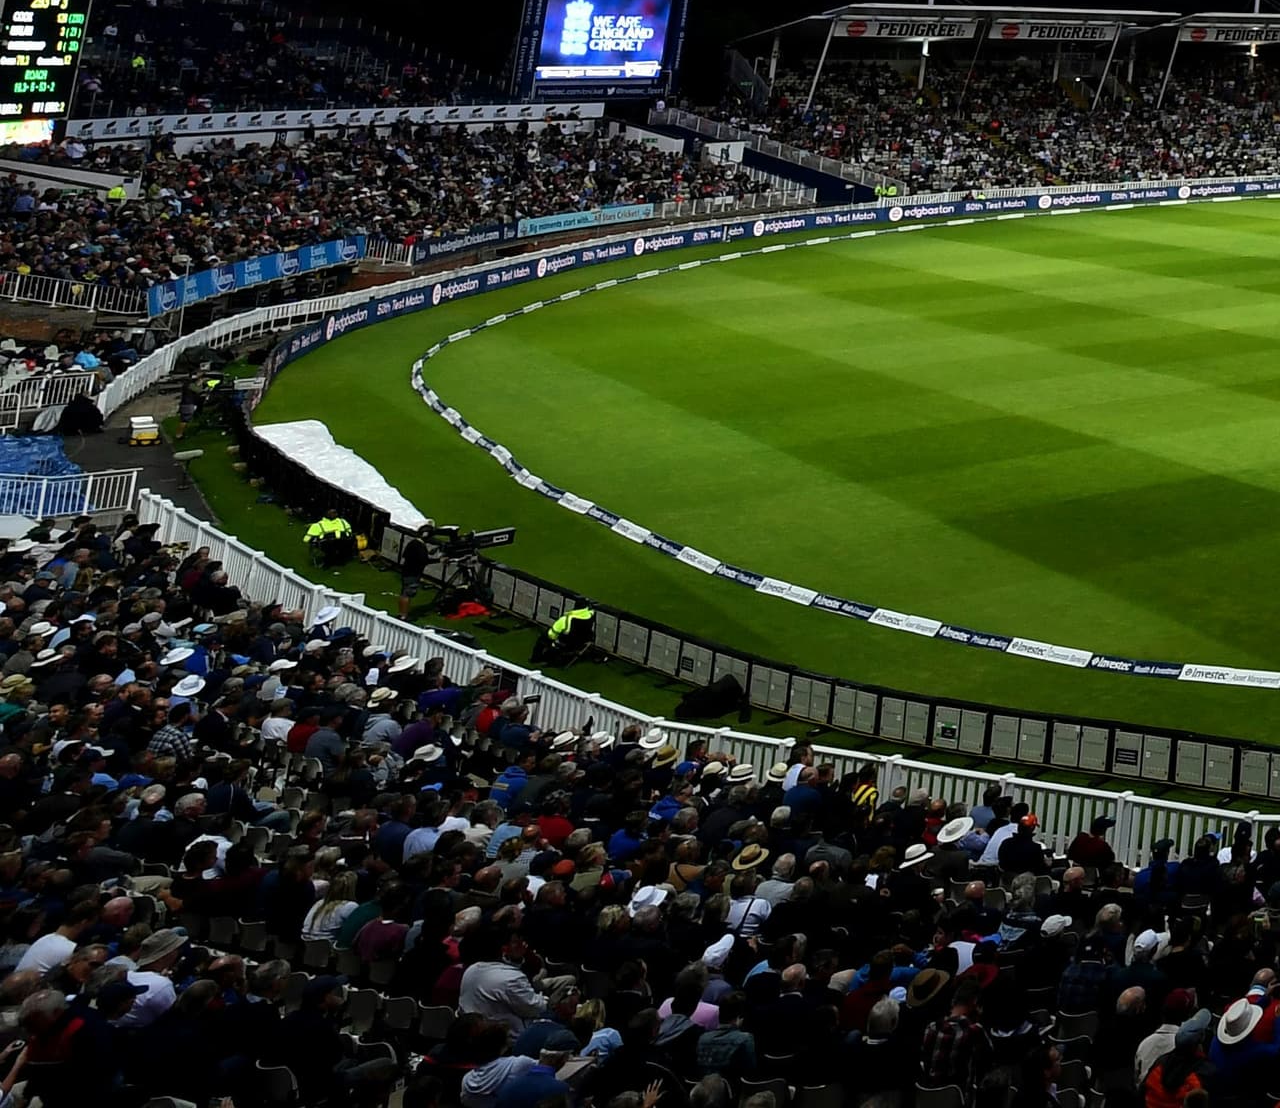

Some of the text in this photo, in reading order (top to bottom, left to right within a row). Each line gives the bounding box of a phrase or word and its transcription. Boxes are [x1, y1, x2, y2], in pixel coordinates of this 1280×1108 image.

[593, 16, 643, 28] WE ARE
[591, 27, 654, 40] ENGLAND
[877, 23, 957, 37] PEDIGREE
[1028, 25, 1099, 39] PEDIGREE
[1215, 29, 1280, 41] PEDIGREE
[589, 39, 645, 52] CRICKET
[1192, 184, 1236, 197] edgbaston
[1262, 182, 1276, 191] Test
[1052, 193, 1100, 206] edgbaston
[1111, 189, 1168, 201] 50th Test Match
[904, 204, 955, 219] edgbaston
[965, 198, 1026, 211] 50th Test Match
[529, 221, 538, 234] Big
[539, 220, 562, 232] moments
[563, 218, 578, 229] start
[602, 210, 616, 222] Stars
[816, 210, 876, 225] 50th Test Match
[764, 218, 805, 233] edgbaston
[645, 234, 684, 251] edgbaston
[582, 244, 626, 261] 50th Test Match
[547, 255, 576, 273] edgbaston
[487, 266, 530, 285] 50th Test Match
[441, 279, 479, 299] edgbaston
[377, 293, 424, 316] 50th Test Match
[334, 309, 368, 332] edgbaston
[944, 627, 970, 642] Investec
[1018, 642, 1047, 655] Investec
[1099, 656, 1132, 671] Investec
[1192, 667, 1229, 681] Investec
